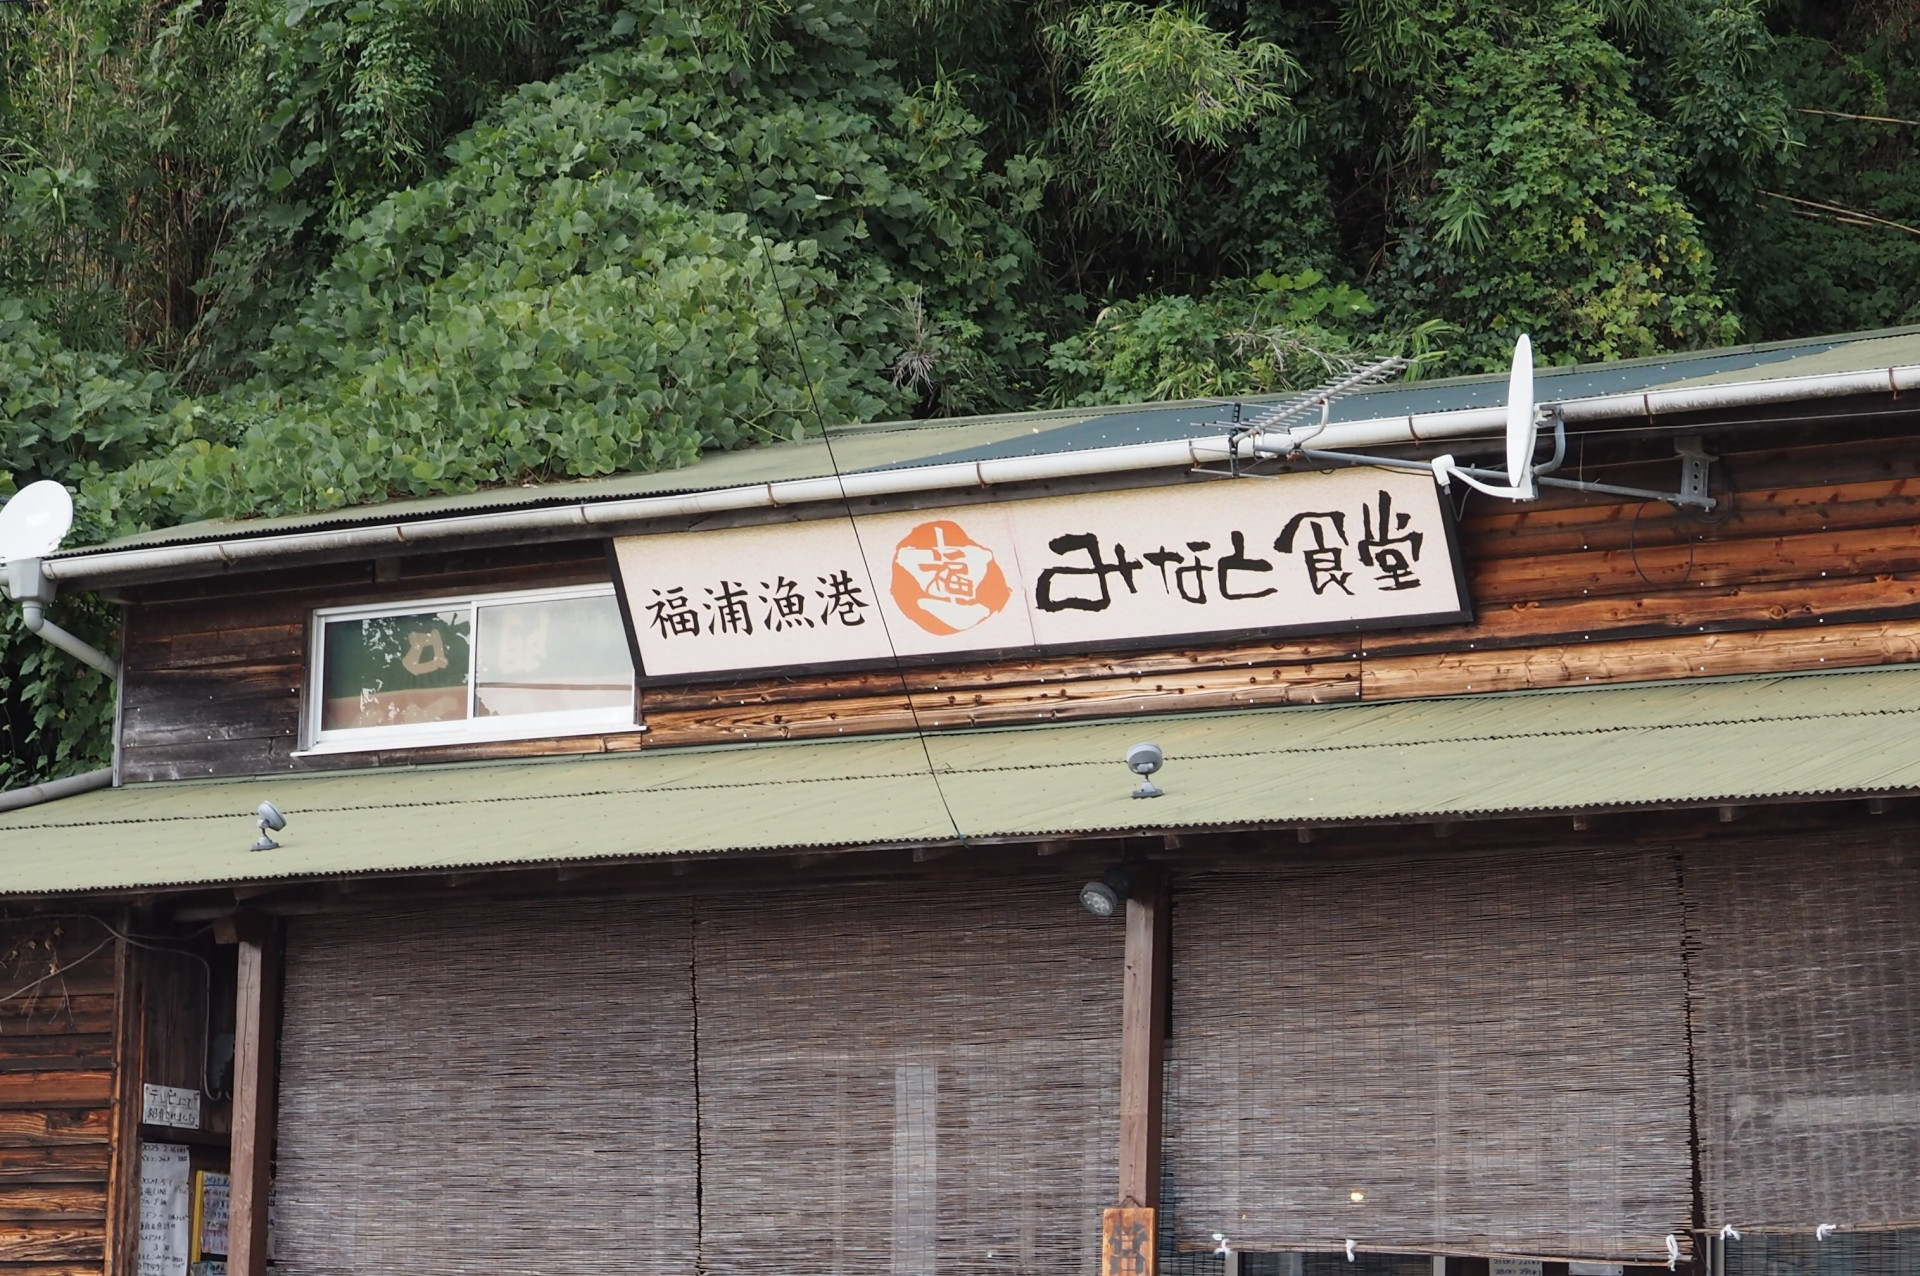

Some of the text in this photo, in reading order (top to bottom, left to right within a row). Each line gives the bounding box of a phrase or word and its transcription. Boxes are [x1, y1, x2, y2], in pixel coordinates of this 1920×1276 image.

[1035, 490, 1424, 612] みなと食堂
[645, 569, 870, 640] 福浦漁港
